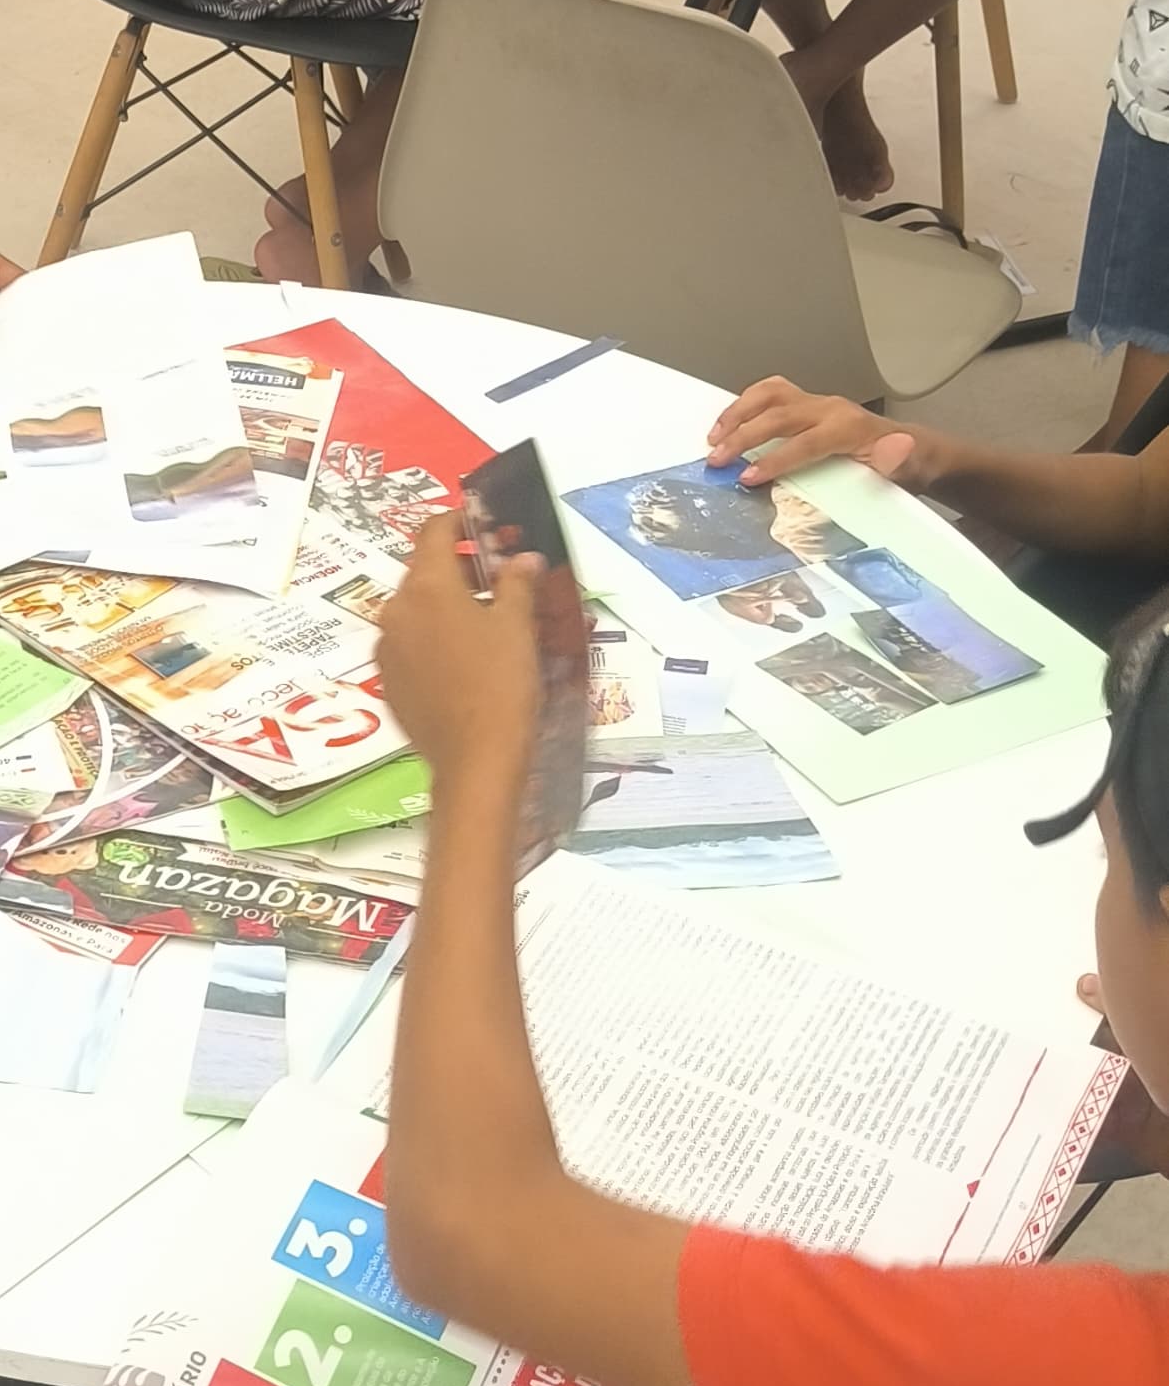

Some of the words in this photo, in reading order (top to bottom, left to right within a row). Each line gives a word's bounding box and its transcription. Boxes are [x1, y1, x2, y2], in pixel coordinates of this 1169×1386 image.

[230, 368, 298, 388] HELLMA
[73, 743, 102, 780] PROTEÇ
[114, 848, 390, 936] Magazan
[199, 896, 286, 930] Moda
[284, 1216, 368, 1277] 3.
